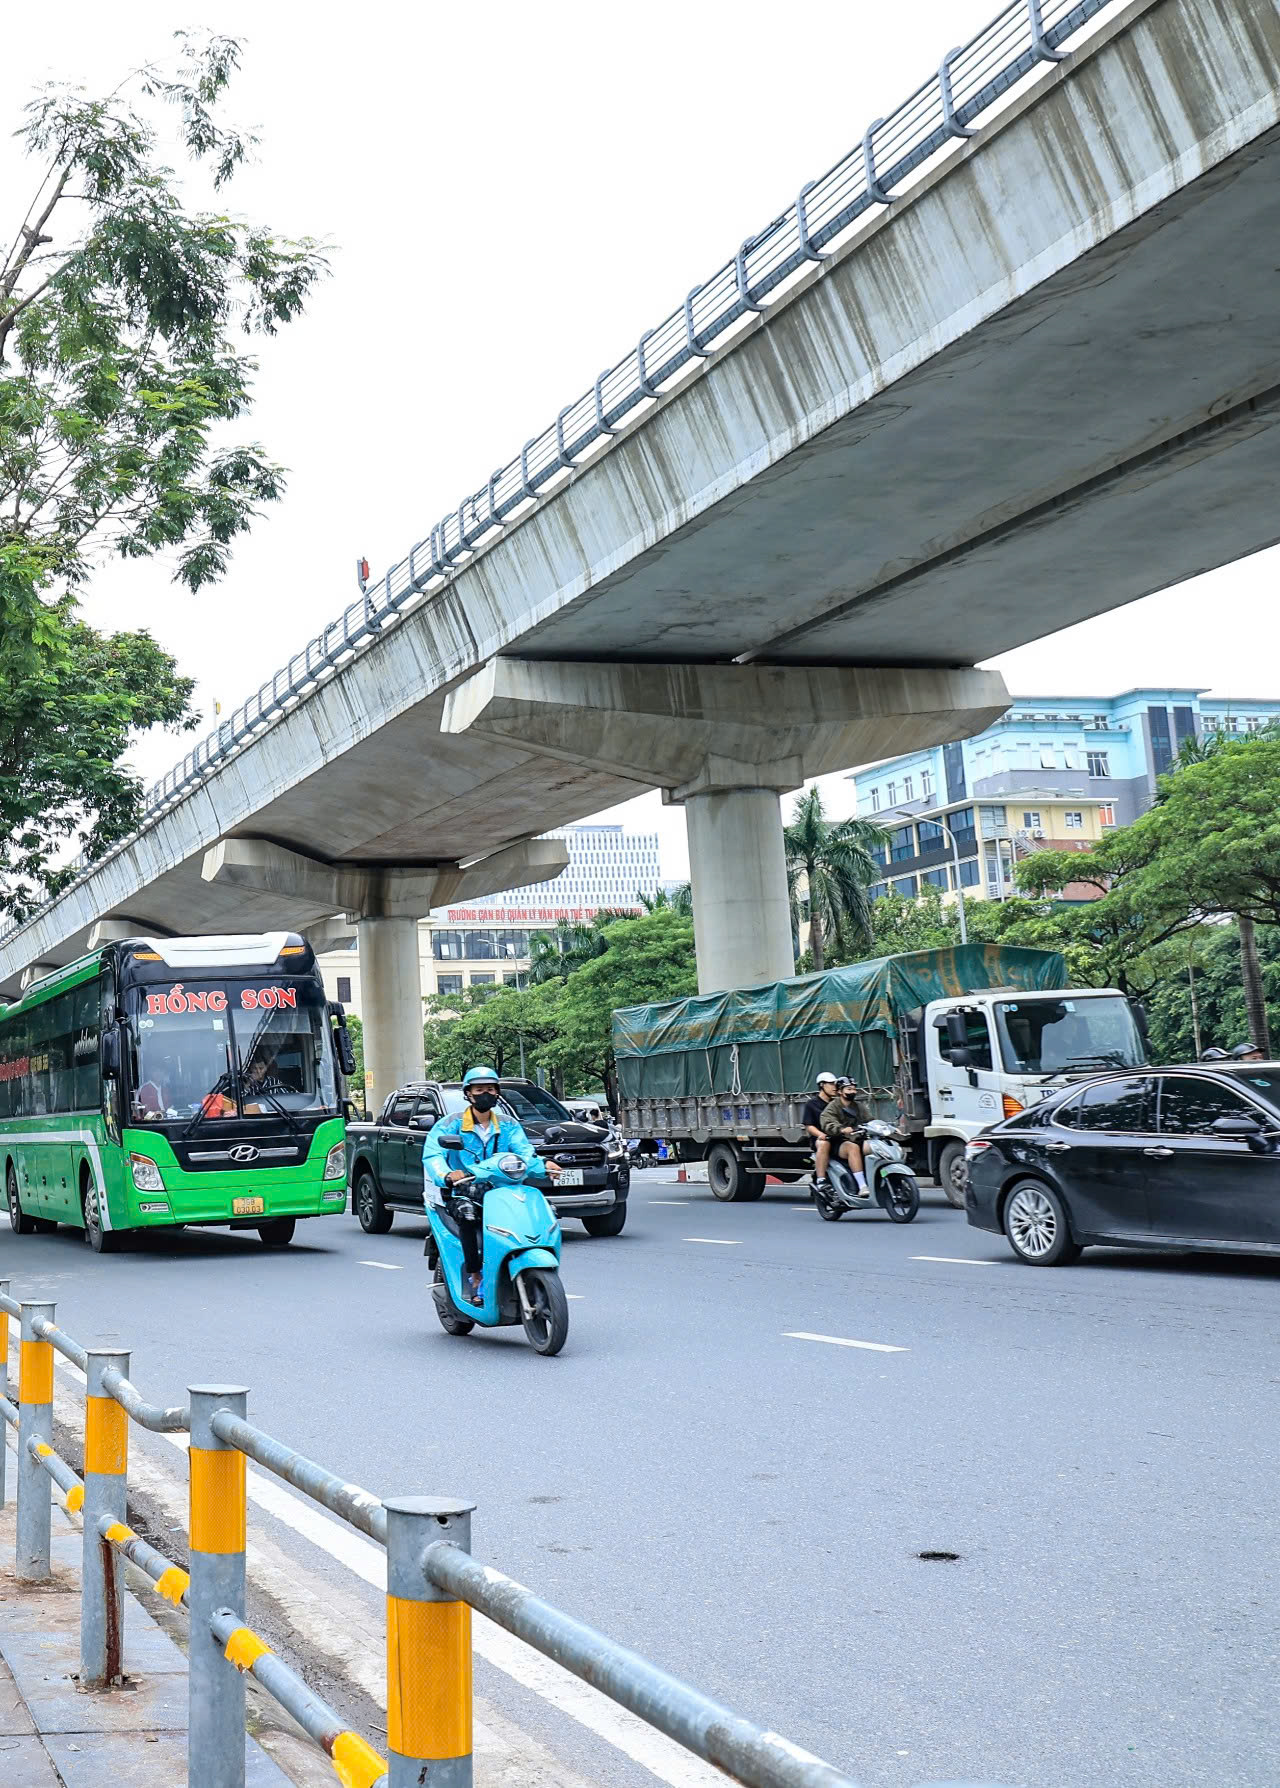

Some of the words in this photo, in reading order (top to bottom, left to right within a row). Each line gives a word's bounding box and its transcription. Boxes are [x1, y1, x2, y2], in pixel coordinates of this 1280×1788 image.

[448, 907, 477, 920] TRƯỜNG
[479, 907, 494, 920] CÁN
[508, 905, 528, 920] QUẢN
[146, 984, 228, 1014] HỒNG
[241, 986, 297, 1009] SƠN
